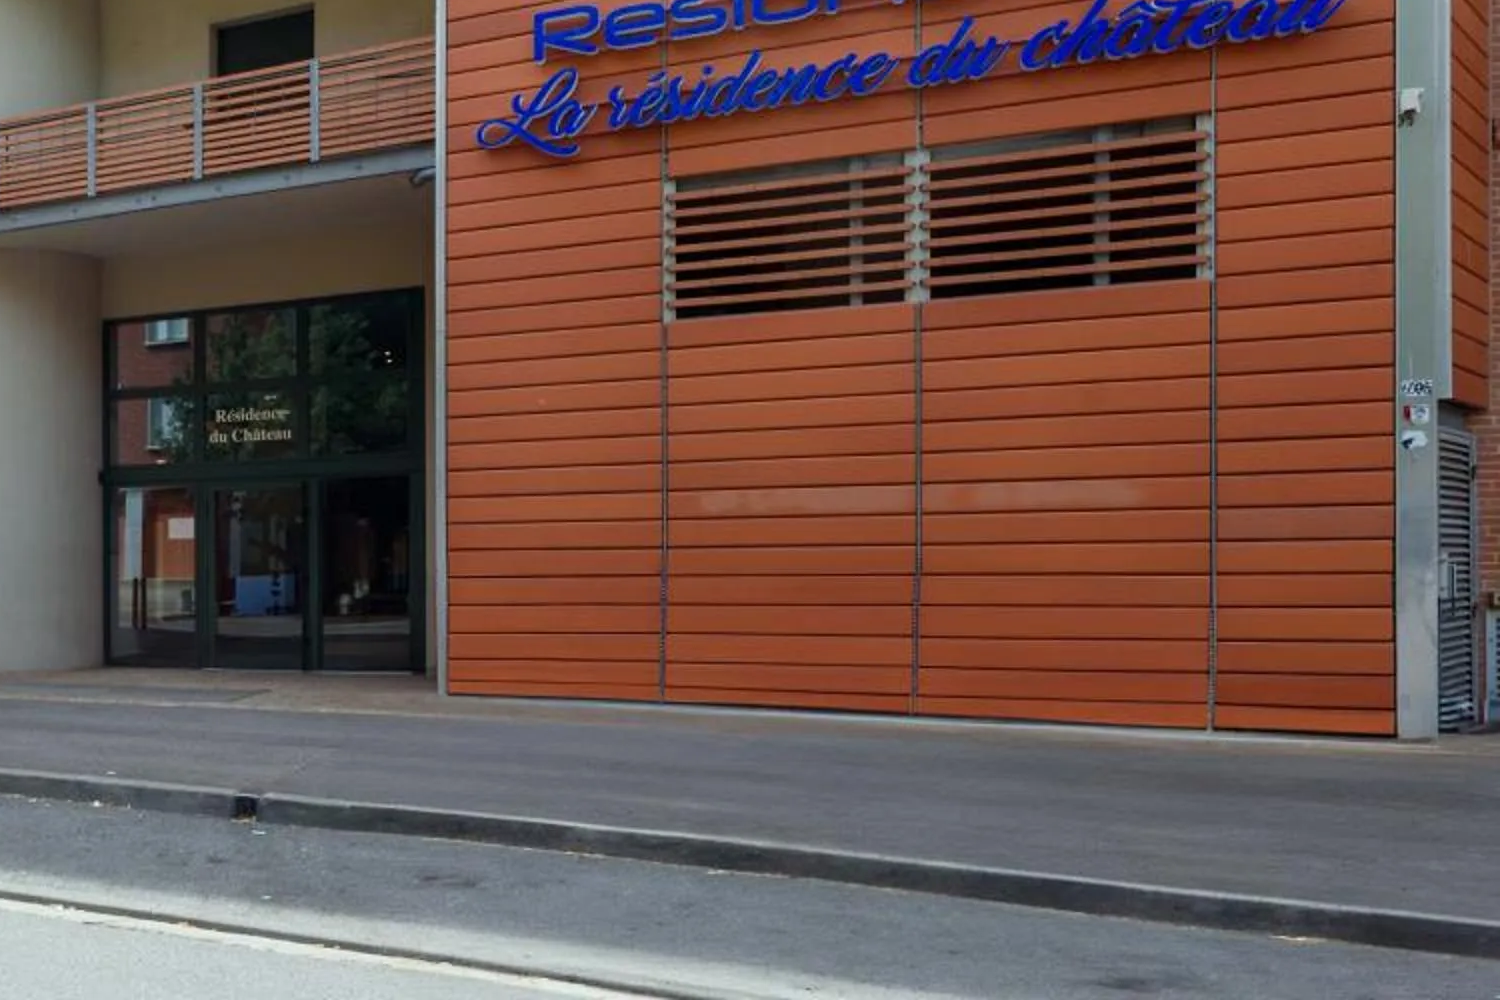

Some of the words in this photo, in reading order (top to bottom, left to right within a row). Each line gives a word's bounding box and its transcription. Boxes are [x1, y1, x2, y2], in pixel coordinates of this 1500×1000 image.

[476, 66, 599, 158] La
[608, 48, 899, 129] résidence
[907, 14, 1011, 89] du
[209, 429, 227, 444] du
[231, 427, 292, 443] Château
